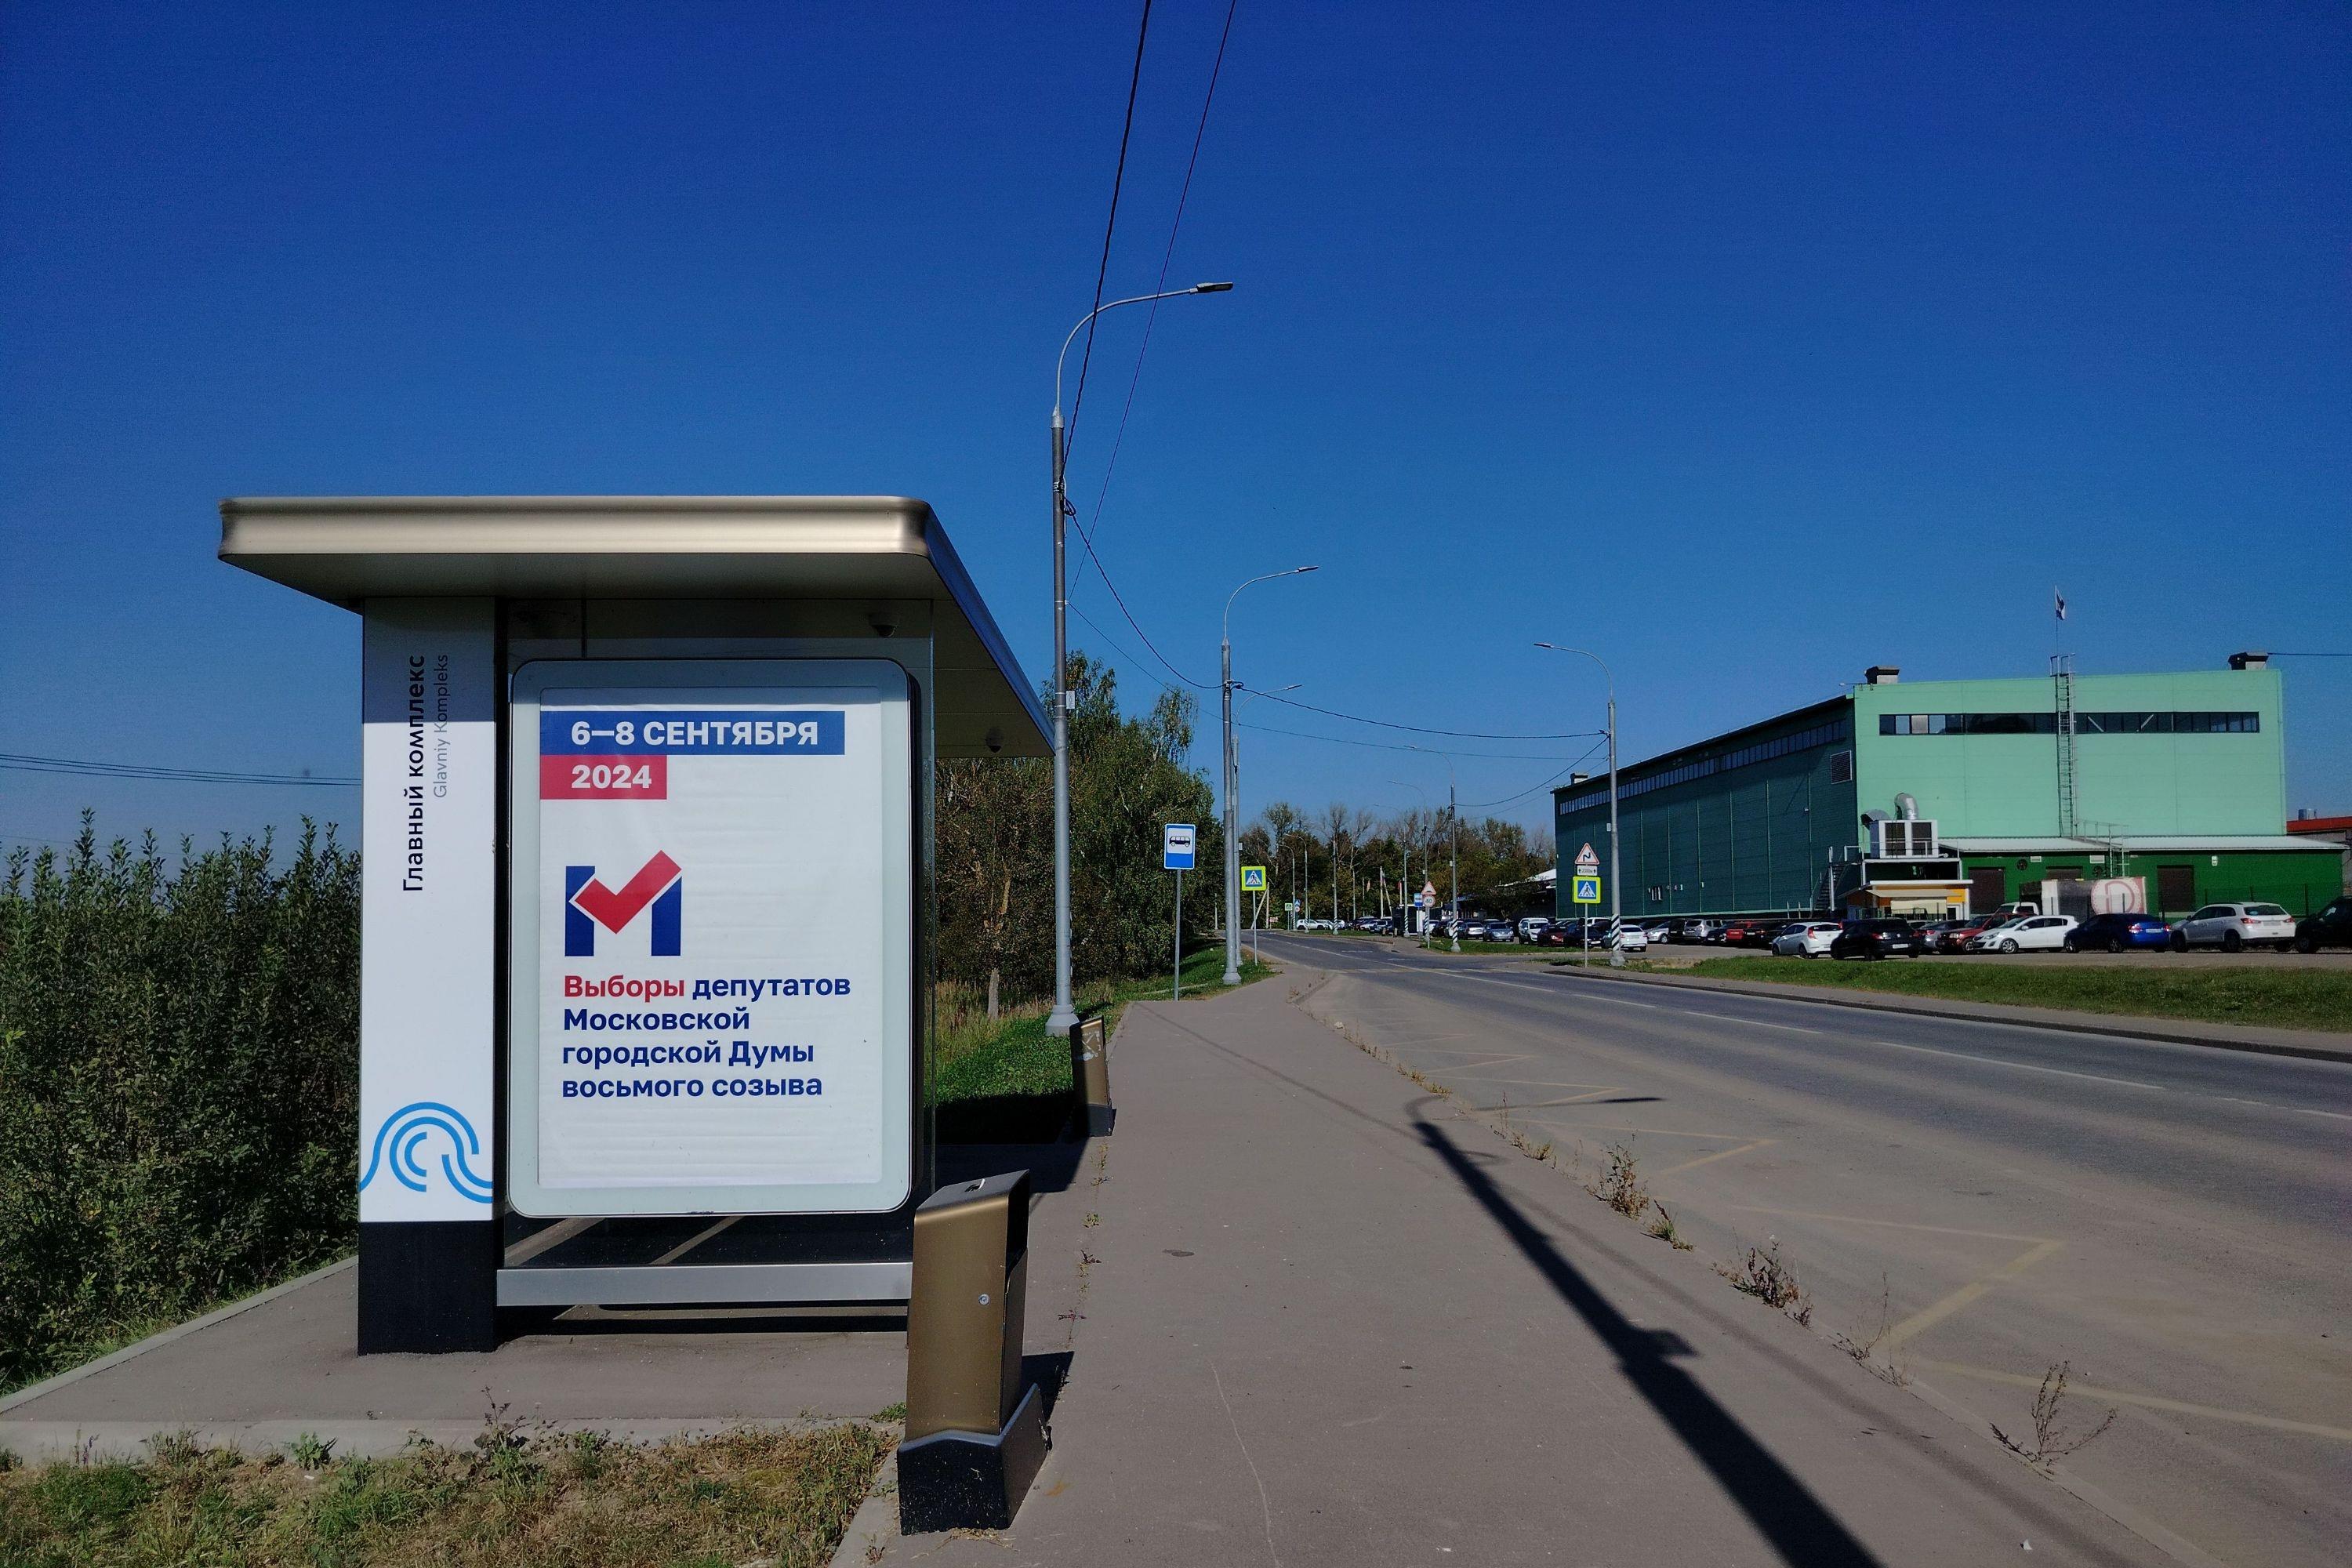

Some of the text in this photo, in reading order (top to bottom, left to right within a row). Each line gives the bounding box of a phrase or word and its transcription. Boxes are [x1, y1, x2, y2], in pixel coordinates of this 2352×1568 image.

[434, 655, 451, 798] Glavniy Kompleks
[643, 721, 818, 745] СЕНТЯБРЯ
[403, 655, 424, 891] Главный комплекс
[572, 764, 652, 789] 2024
[564, 975, 851, 1003] Выборы депутатов
[564, 1007, 750, 1031] Московской
[563, 1040, 814, 1069] городской Думы
[562, 1078, 822, 1098] восьмого созыва
